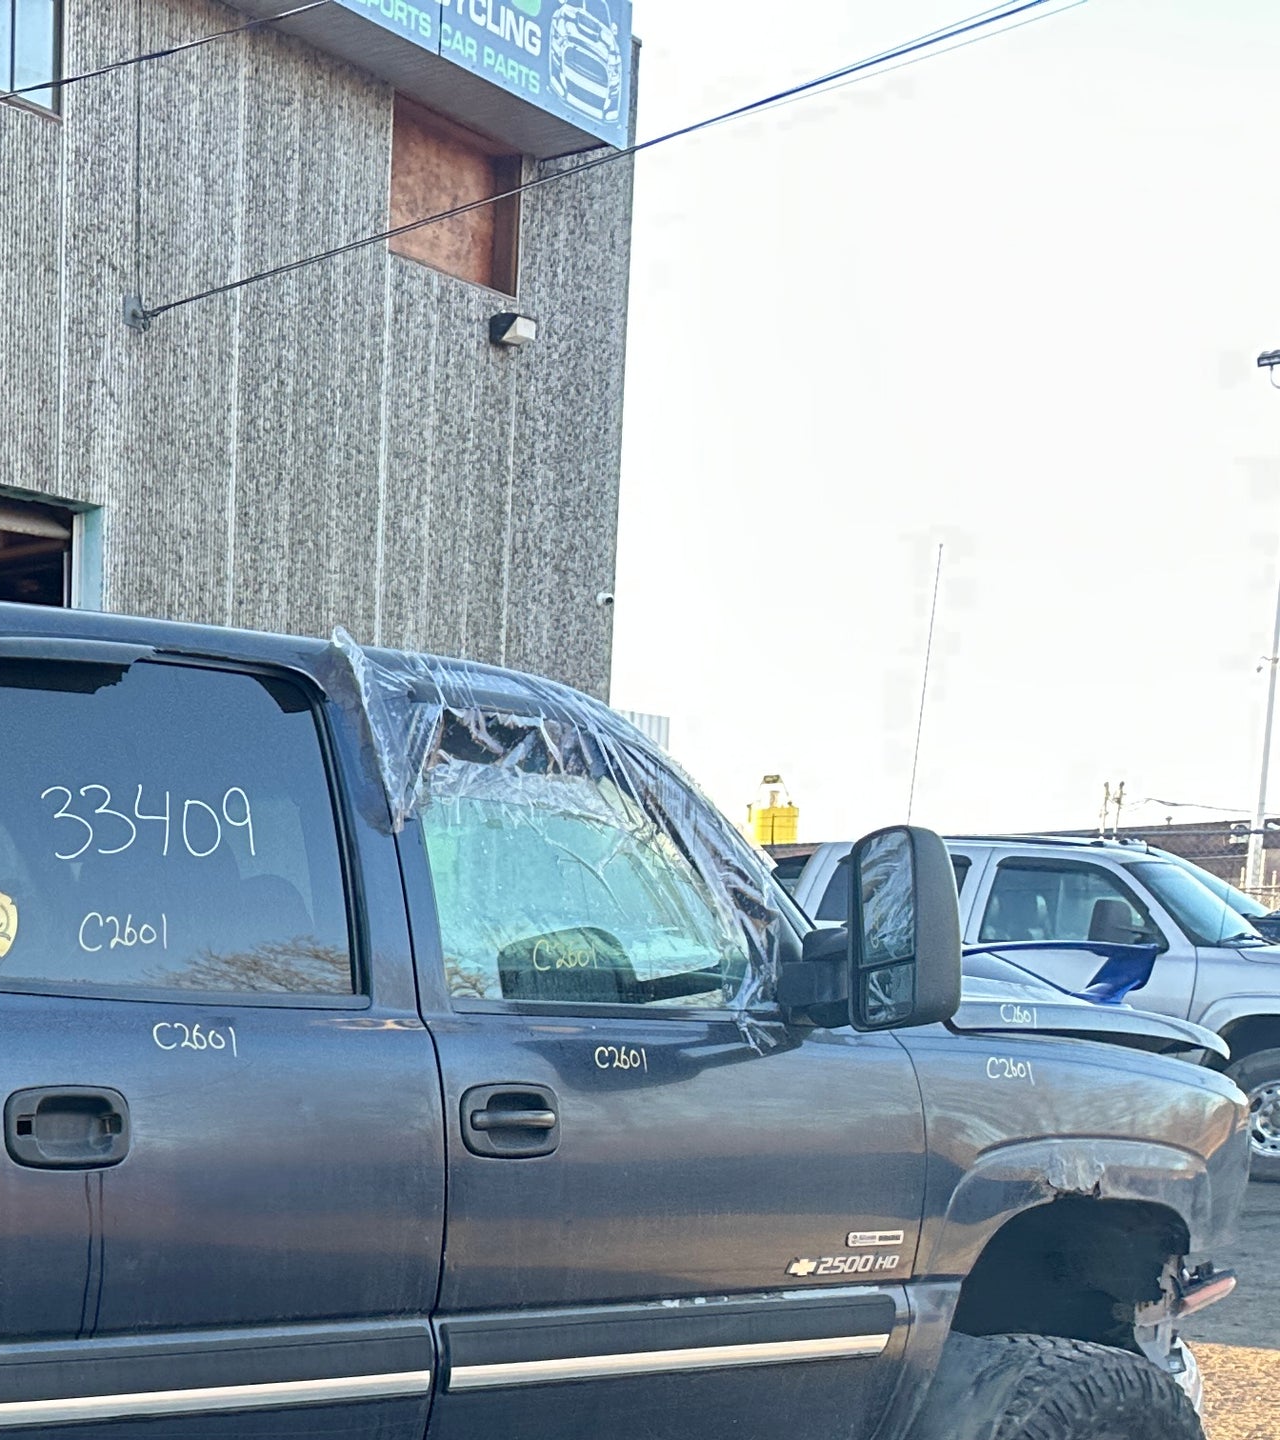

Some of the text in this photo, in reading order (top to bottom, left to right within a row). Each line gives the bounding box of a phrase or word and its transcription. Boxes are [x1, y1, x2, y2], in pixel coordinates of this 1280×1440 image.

[434, 0, 541, 56] CLING
[441, 22, 478, 62] CAR
[484, 46, 541, 95] PARTS
[40, 784, 256, 859] 33409
[78, 912, 168, 952] C2601
[532, 939, 599, 971] C2601
[1000, 1004, 1037, 1029] C2601
[152, 1022, 238, 1057] C2601
[594, 1046, 648, 1073] C2601
[986, 1056, 1036, 1086] C2601
[816, 1254, 900, 1275] 2500 HD
